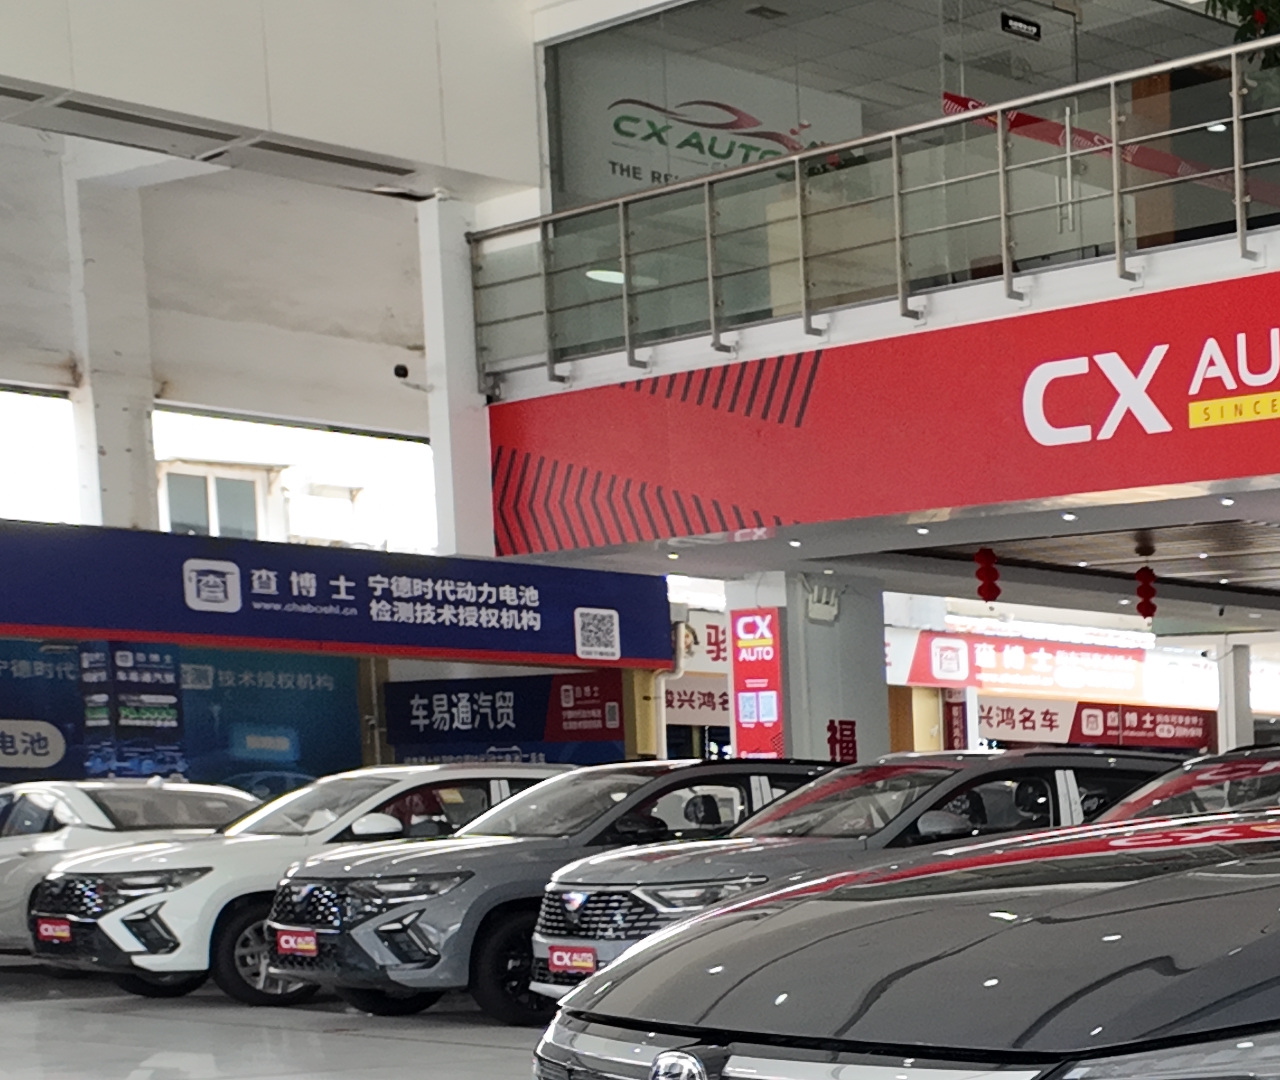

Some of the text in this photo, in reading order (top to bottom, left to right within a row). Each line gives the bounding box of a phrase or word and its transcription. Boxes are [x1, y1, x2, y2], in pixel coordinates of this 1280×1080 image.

[612, 114, 673, 146] CX
[608, 160, 643, 181] THE
[1021, 343, 1174, 447] CX
[1201, 398, 1280, 423] SINCE
[250, 568, 357, 600] 查博士
[367, 573, 541, 608] 宁德时代动力电池
[369, 600, 542, 632] 检测技术授权机构
[735, 613, 773, 640] CX
[738, 646, 774, 662] AUTO
[410, 690, 517, 733] 车易通汽贸
[978, 704, 1060, 732] 兴鸿名车
[0, 730, 50, 757] 电池
[826, 719, 858, 764] 福
